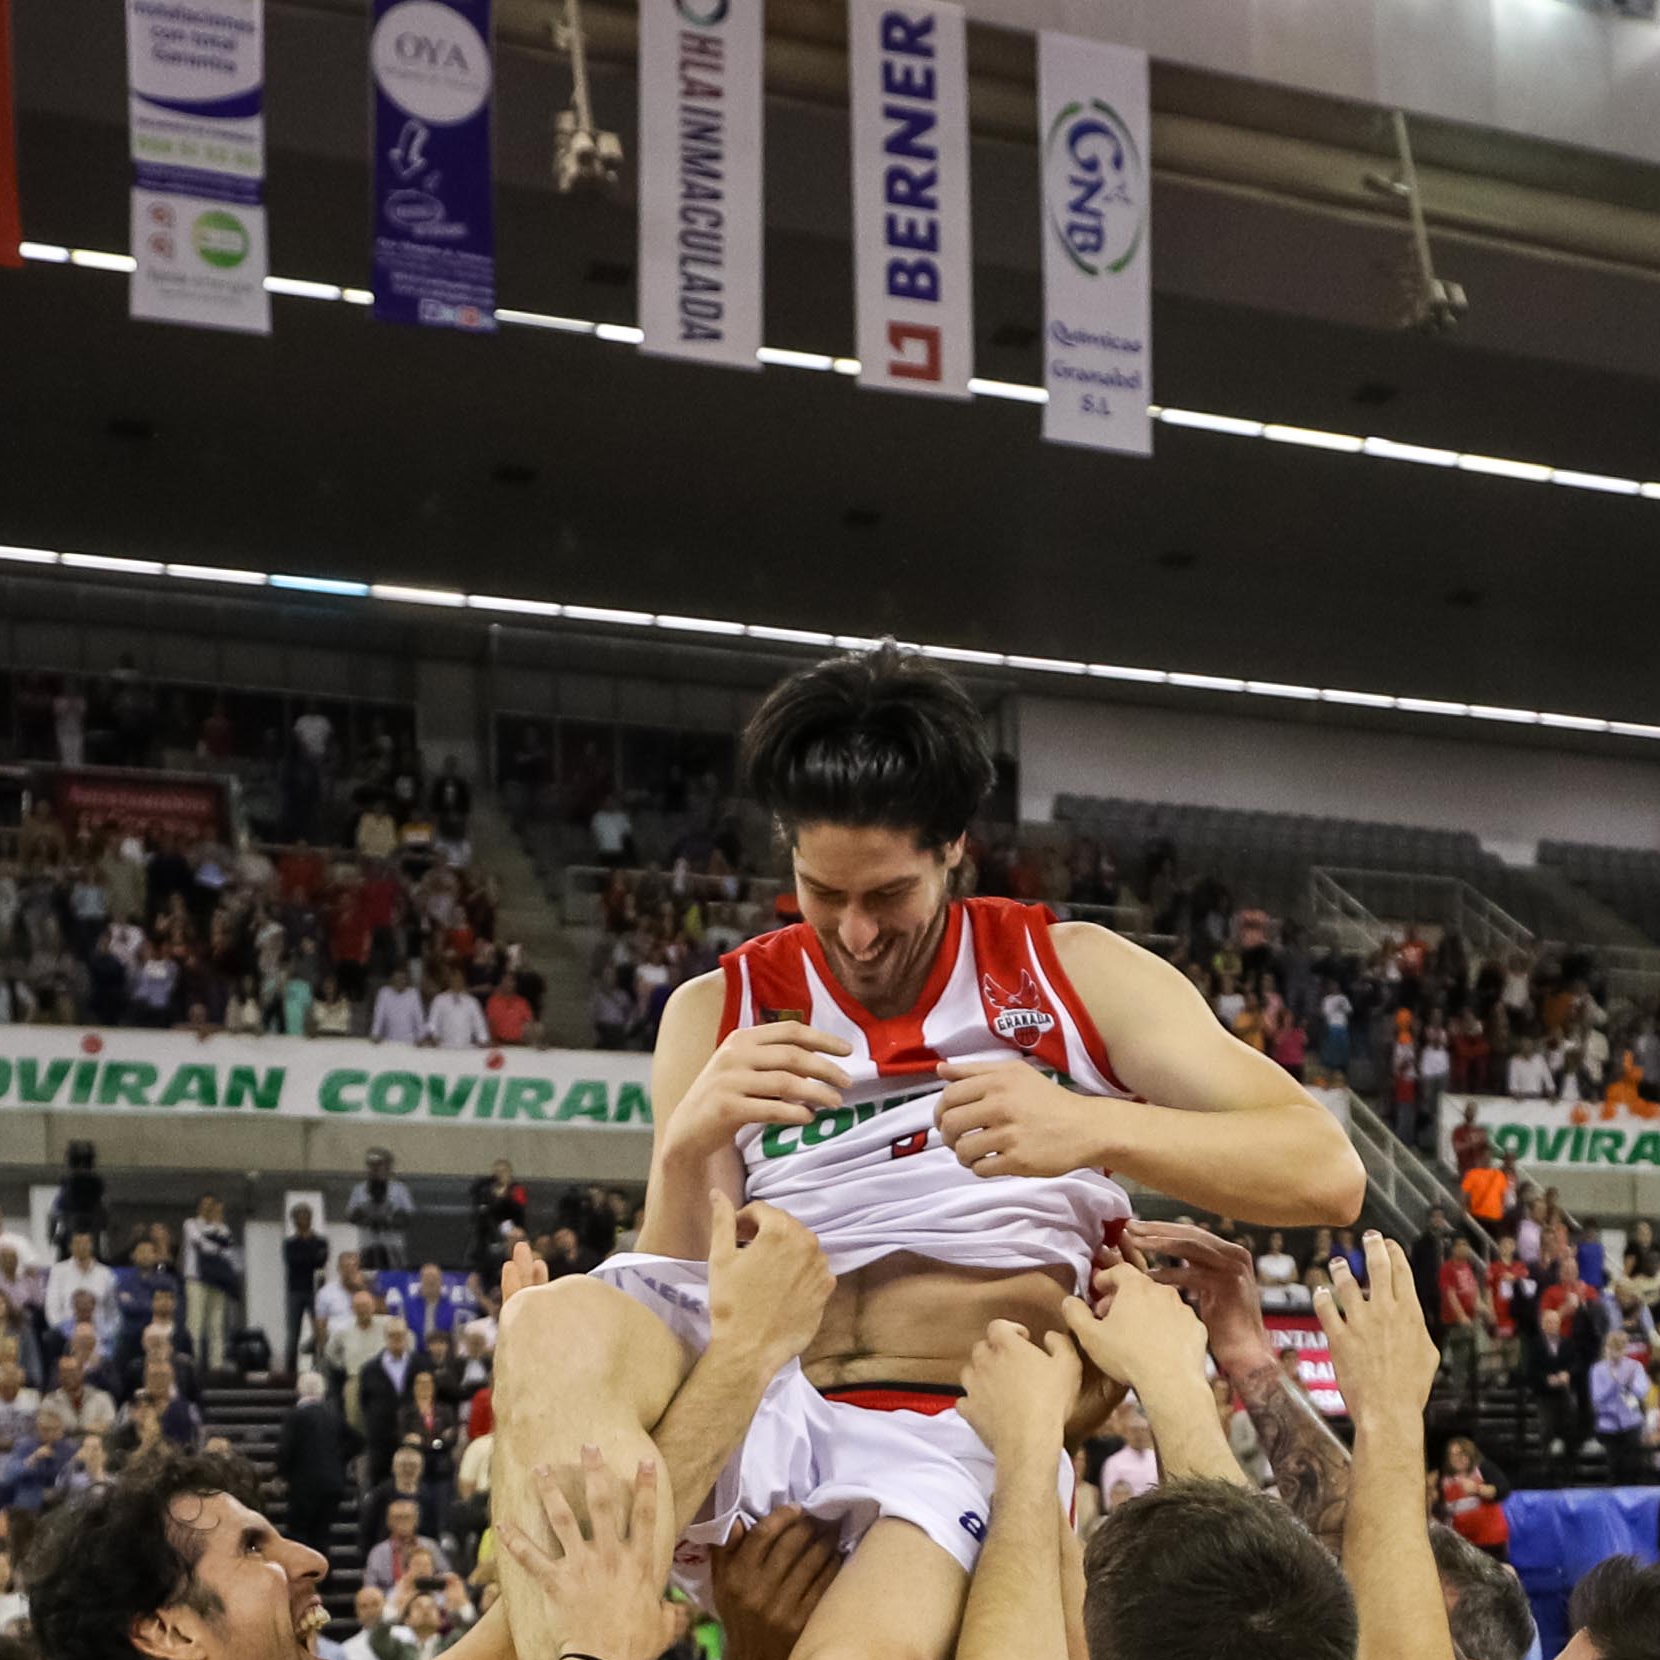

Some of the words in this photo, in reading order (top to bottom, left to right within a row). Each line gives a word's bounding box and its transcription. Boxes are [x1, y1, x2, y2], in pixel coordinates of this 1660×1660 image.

[394, 31, 470, 72] OYA
[881, 10, 940, 303] BERNER
[1066, 118, 1124, 253] GNB
